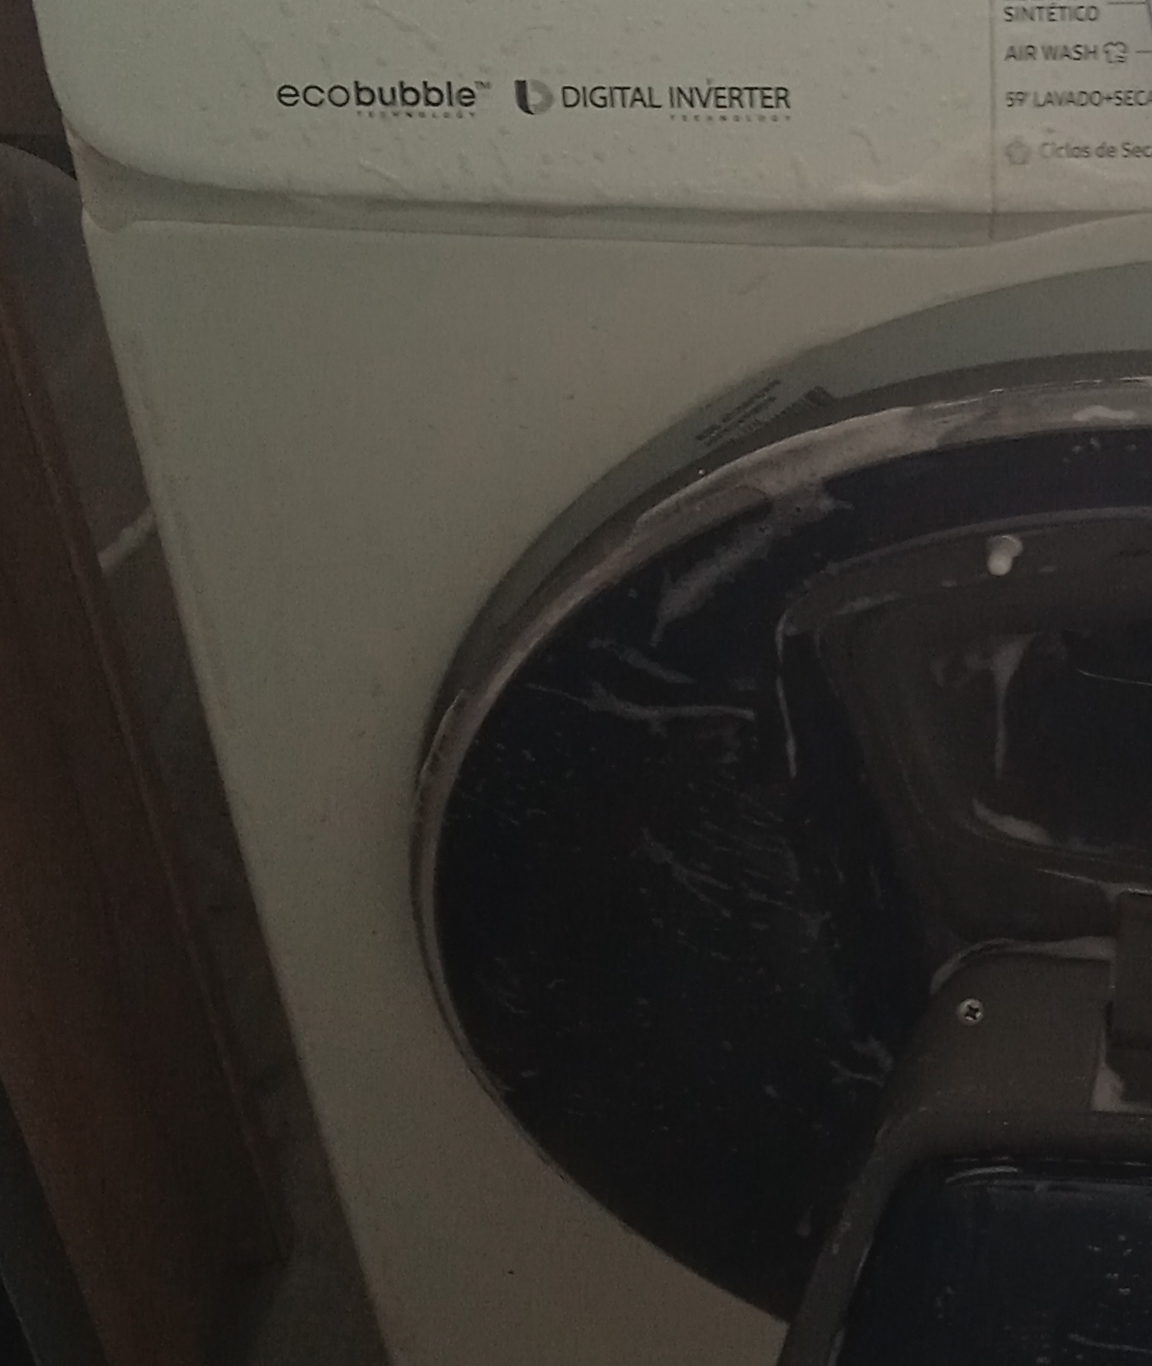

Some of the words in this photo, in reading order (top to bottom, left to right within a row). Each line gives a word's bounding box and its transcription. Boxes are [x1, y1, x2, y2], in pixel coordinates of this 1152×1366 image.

[1003, 3, 1099, 22] SINTÉTICO
[1004, 45, 1037, 61] AIR
[1041, 44, 1099, 62] WASH
[561, 85, 662, 109] DIGITAL
[668, 85, 791, 109] INVERTER
[1038, 141, 1090, 159] Ciclos
[1094, 141, 1116, 159] de
